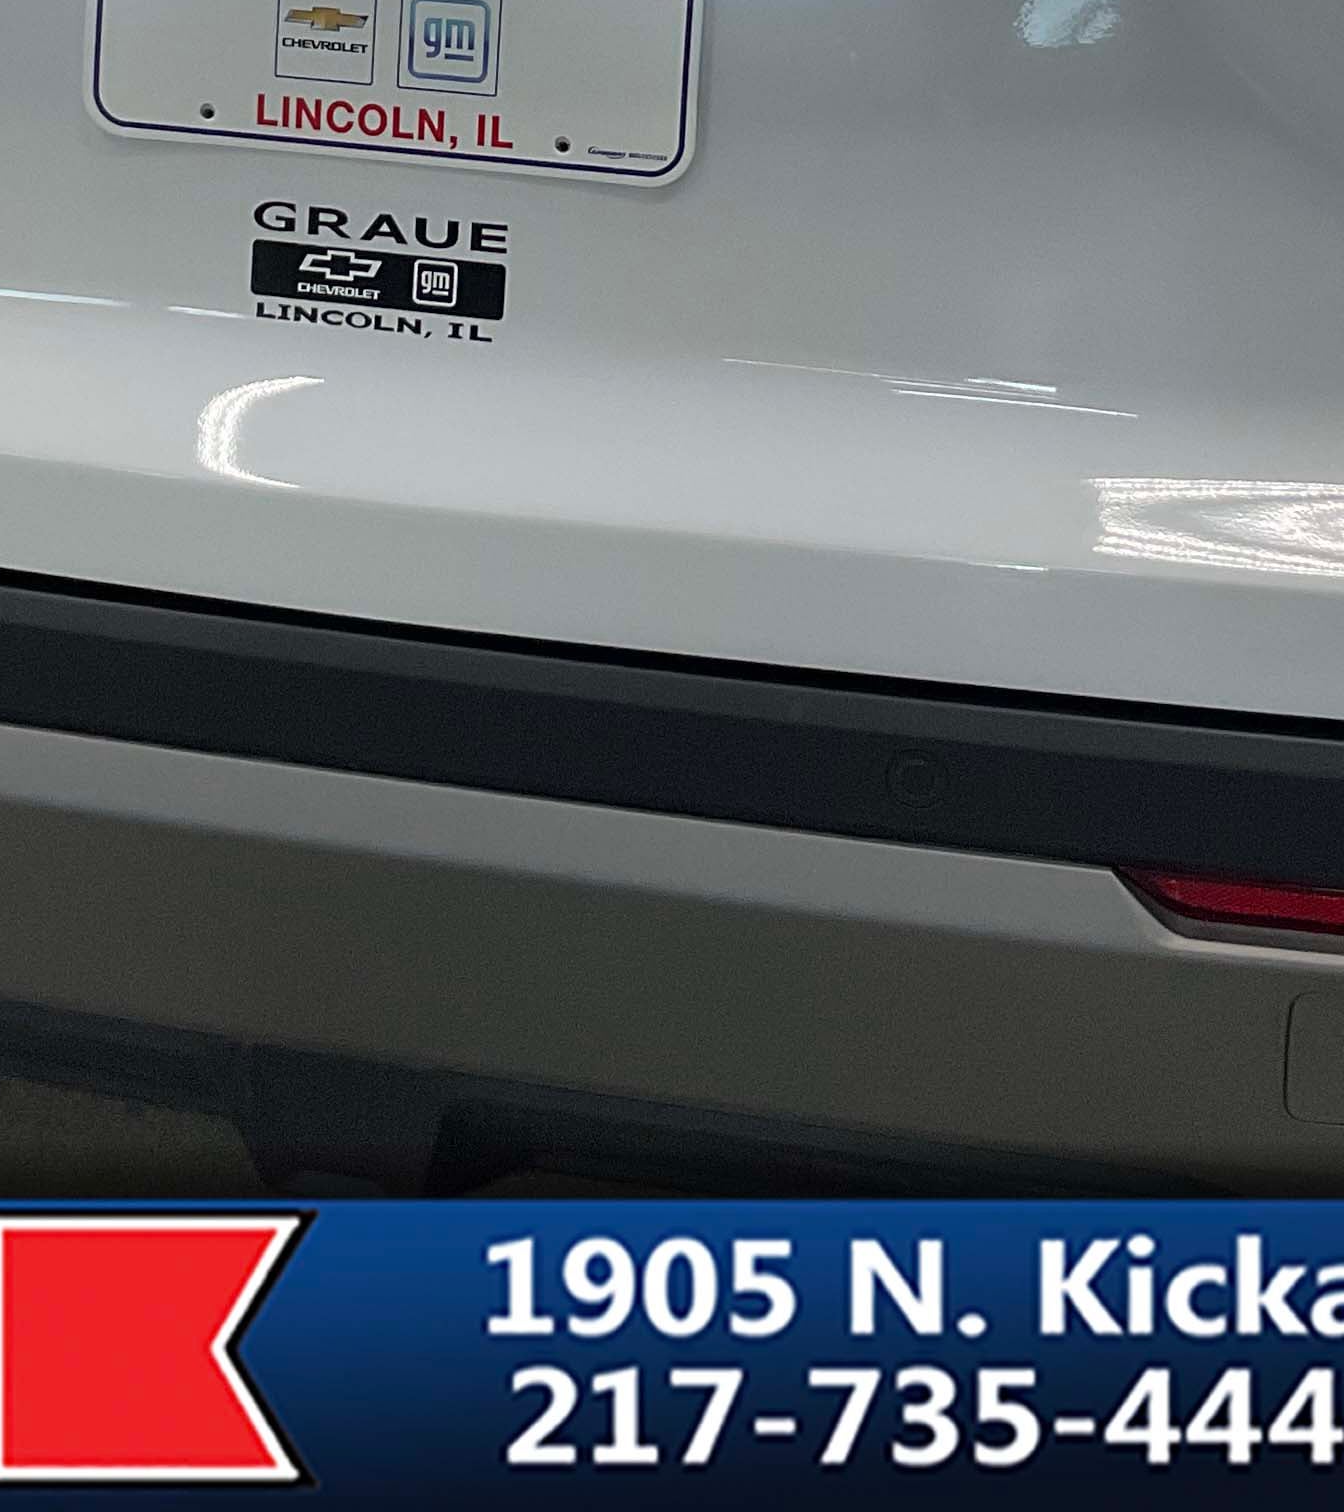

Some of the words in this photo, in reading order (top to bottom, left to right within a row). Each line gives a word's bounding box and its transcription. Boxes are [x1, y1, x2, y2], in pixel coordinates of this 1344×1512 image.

[281, 36, 369, 55] CHEVROLET
[423, 15, 475, 59] gm
[256, 93, 458, 150] LINCOLN,
[476, 113, 513, 149] IL
[253, 201, 509, 254] GRAUE
[297, 282, 381, 300] CHEVROLET
[421, 269, 450, 292] gm
[256, 302, 433, 339] LINCOLN,
[448, 322, 493, 343] IL
